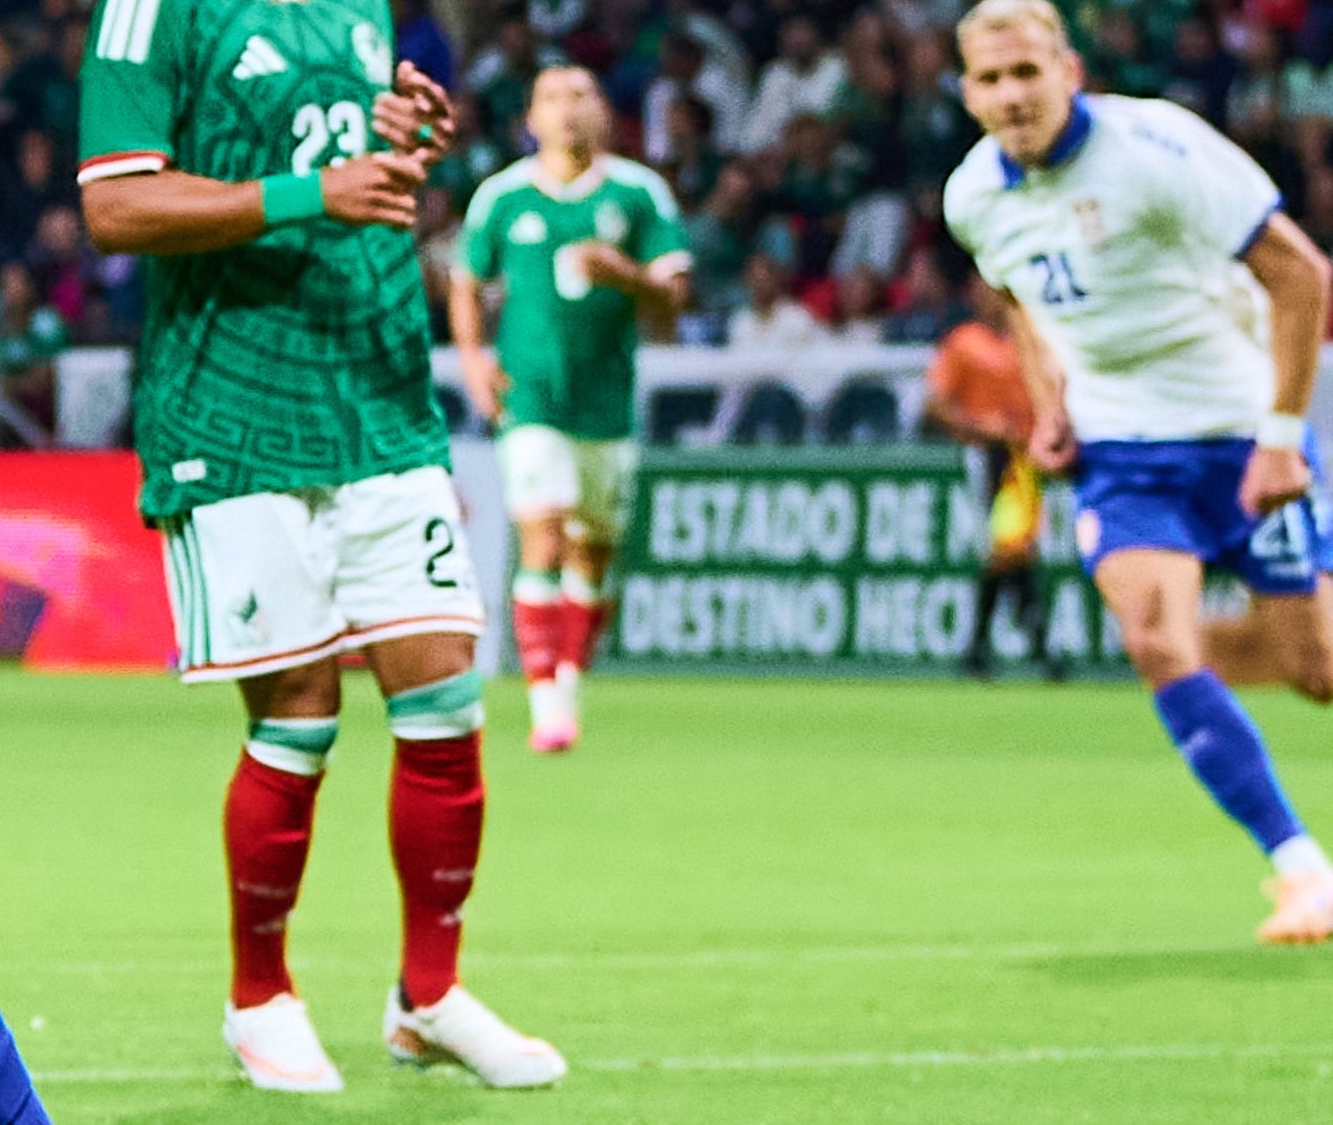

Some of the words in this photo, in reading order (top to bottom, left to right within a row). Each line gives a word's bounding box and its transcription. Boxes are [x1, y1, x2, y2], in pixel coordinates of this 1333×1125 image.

[291, 100, 367, 178] 23
[650, 479, 852, 563] ESTADO
[865, 479, 931, 565] DE
[622, 577, 846, 654] DESTINO
